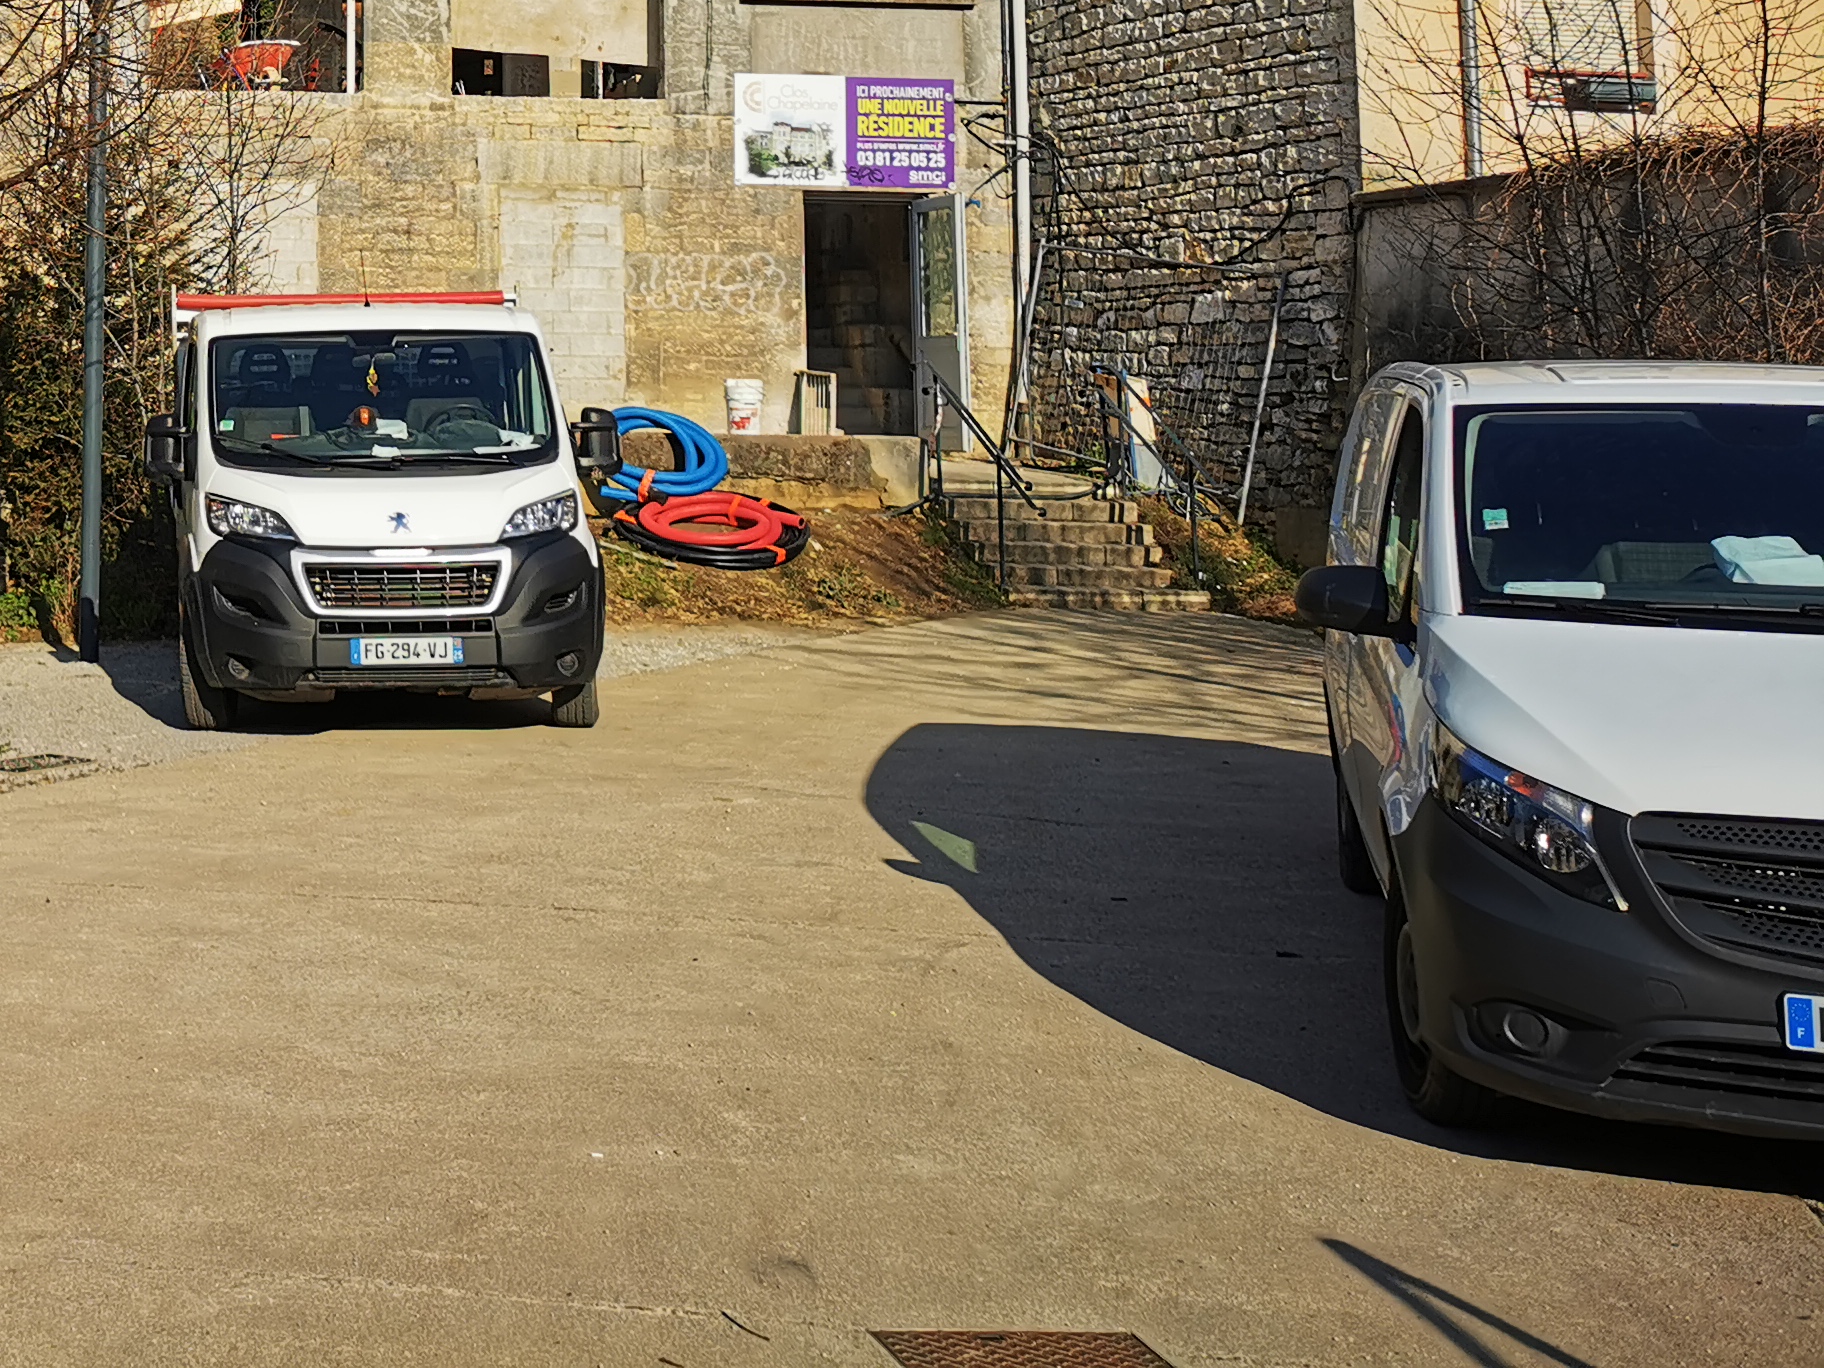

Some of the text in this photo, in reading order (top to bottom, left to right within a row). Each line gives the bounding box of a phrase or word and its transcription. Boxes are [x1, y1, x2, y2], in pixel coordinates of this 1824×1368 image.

[780, 83, 808, 98] Clos
[857, 85, 944, 99] ICI PROCHAINEMENT
[767, 96, 838, 111] Chapelaine
[857, 98, 944, 116] UNE NOUVELLE
[857, 113, 945, 138] RÉSIDENCE
[857, 151, 946, 168] 03 81 25 05 25
[909, 170, 946, 182] smci
[1797, 1027, 1805, 1039] F
